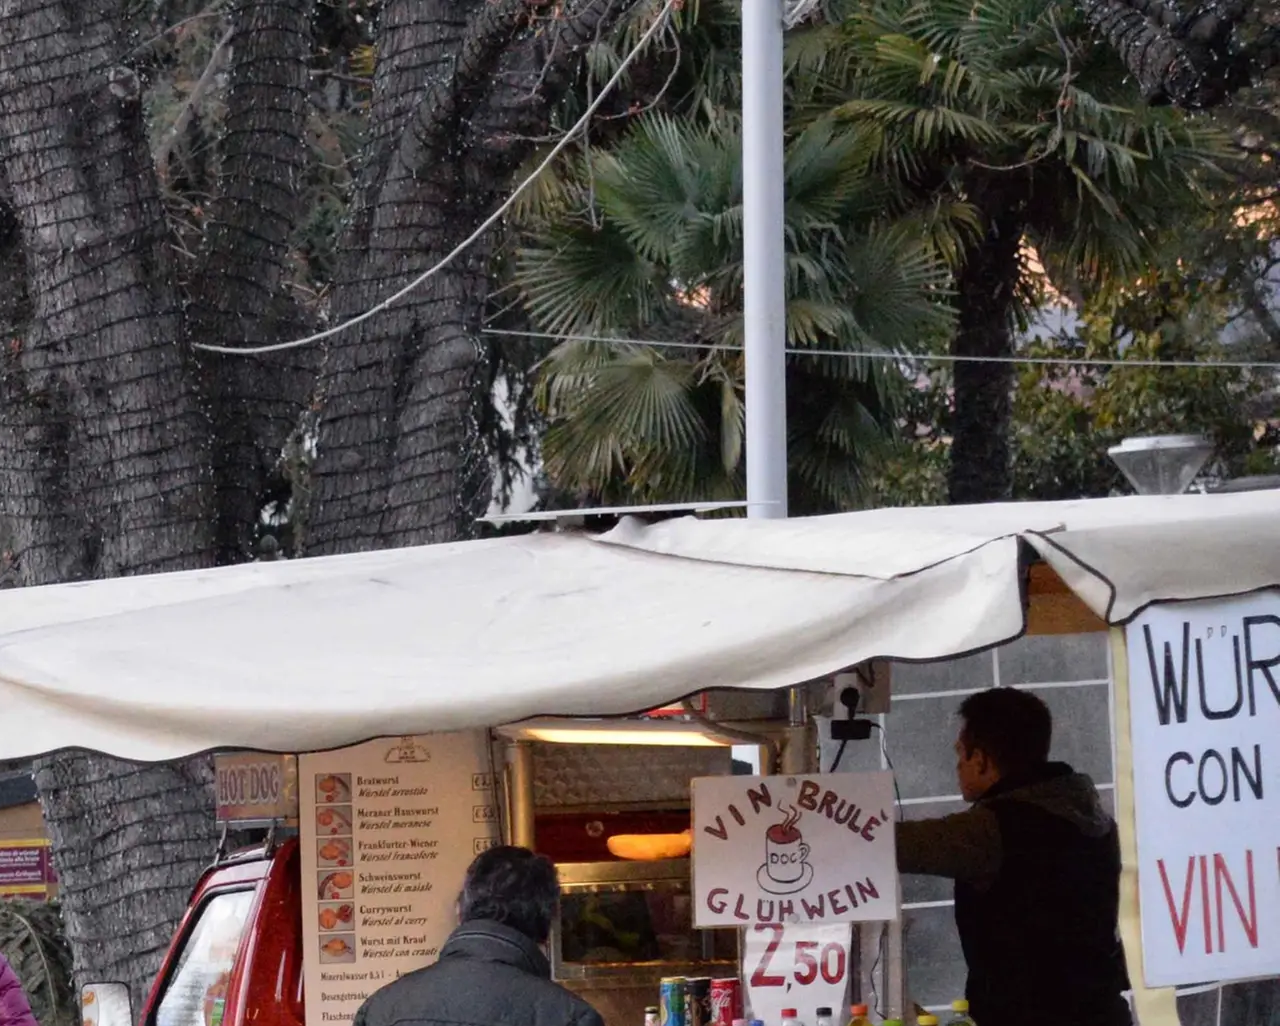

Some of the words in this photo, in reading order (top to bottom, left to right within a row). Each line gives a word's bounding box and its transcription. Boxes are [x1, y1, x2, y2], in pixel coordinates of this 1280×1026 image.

[219, 766, 246, 804] HOT
[249, 763, 280, 804] DOG
[357, 776, 399, 785] Bratwurst
[1164, 744, 1264, 808] CON
[358, 808, 391, 818] Meraner
[704, 783, 773, 840] VIN
[359, 905, 412, 915] Currywurst
[707, 877, 880, 922] GLÜHWEIN
[1156, 849, 1259, 956] VIN
[387, 936, 400, 945] mit
[403, 935, 426, 944] Kraut
[750, 923, 846, 993] 2,50
[322, 1012, 355, 1022] Flascheng
